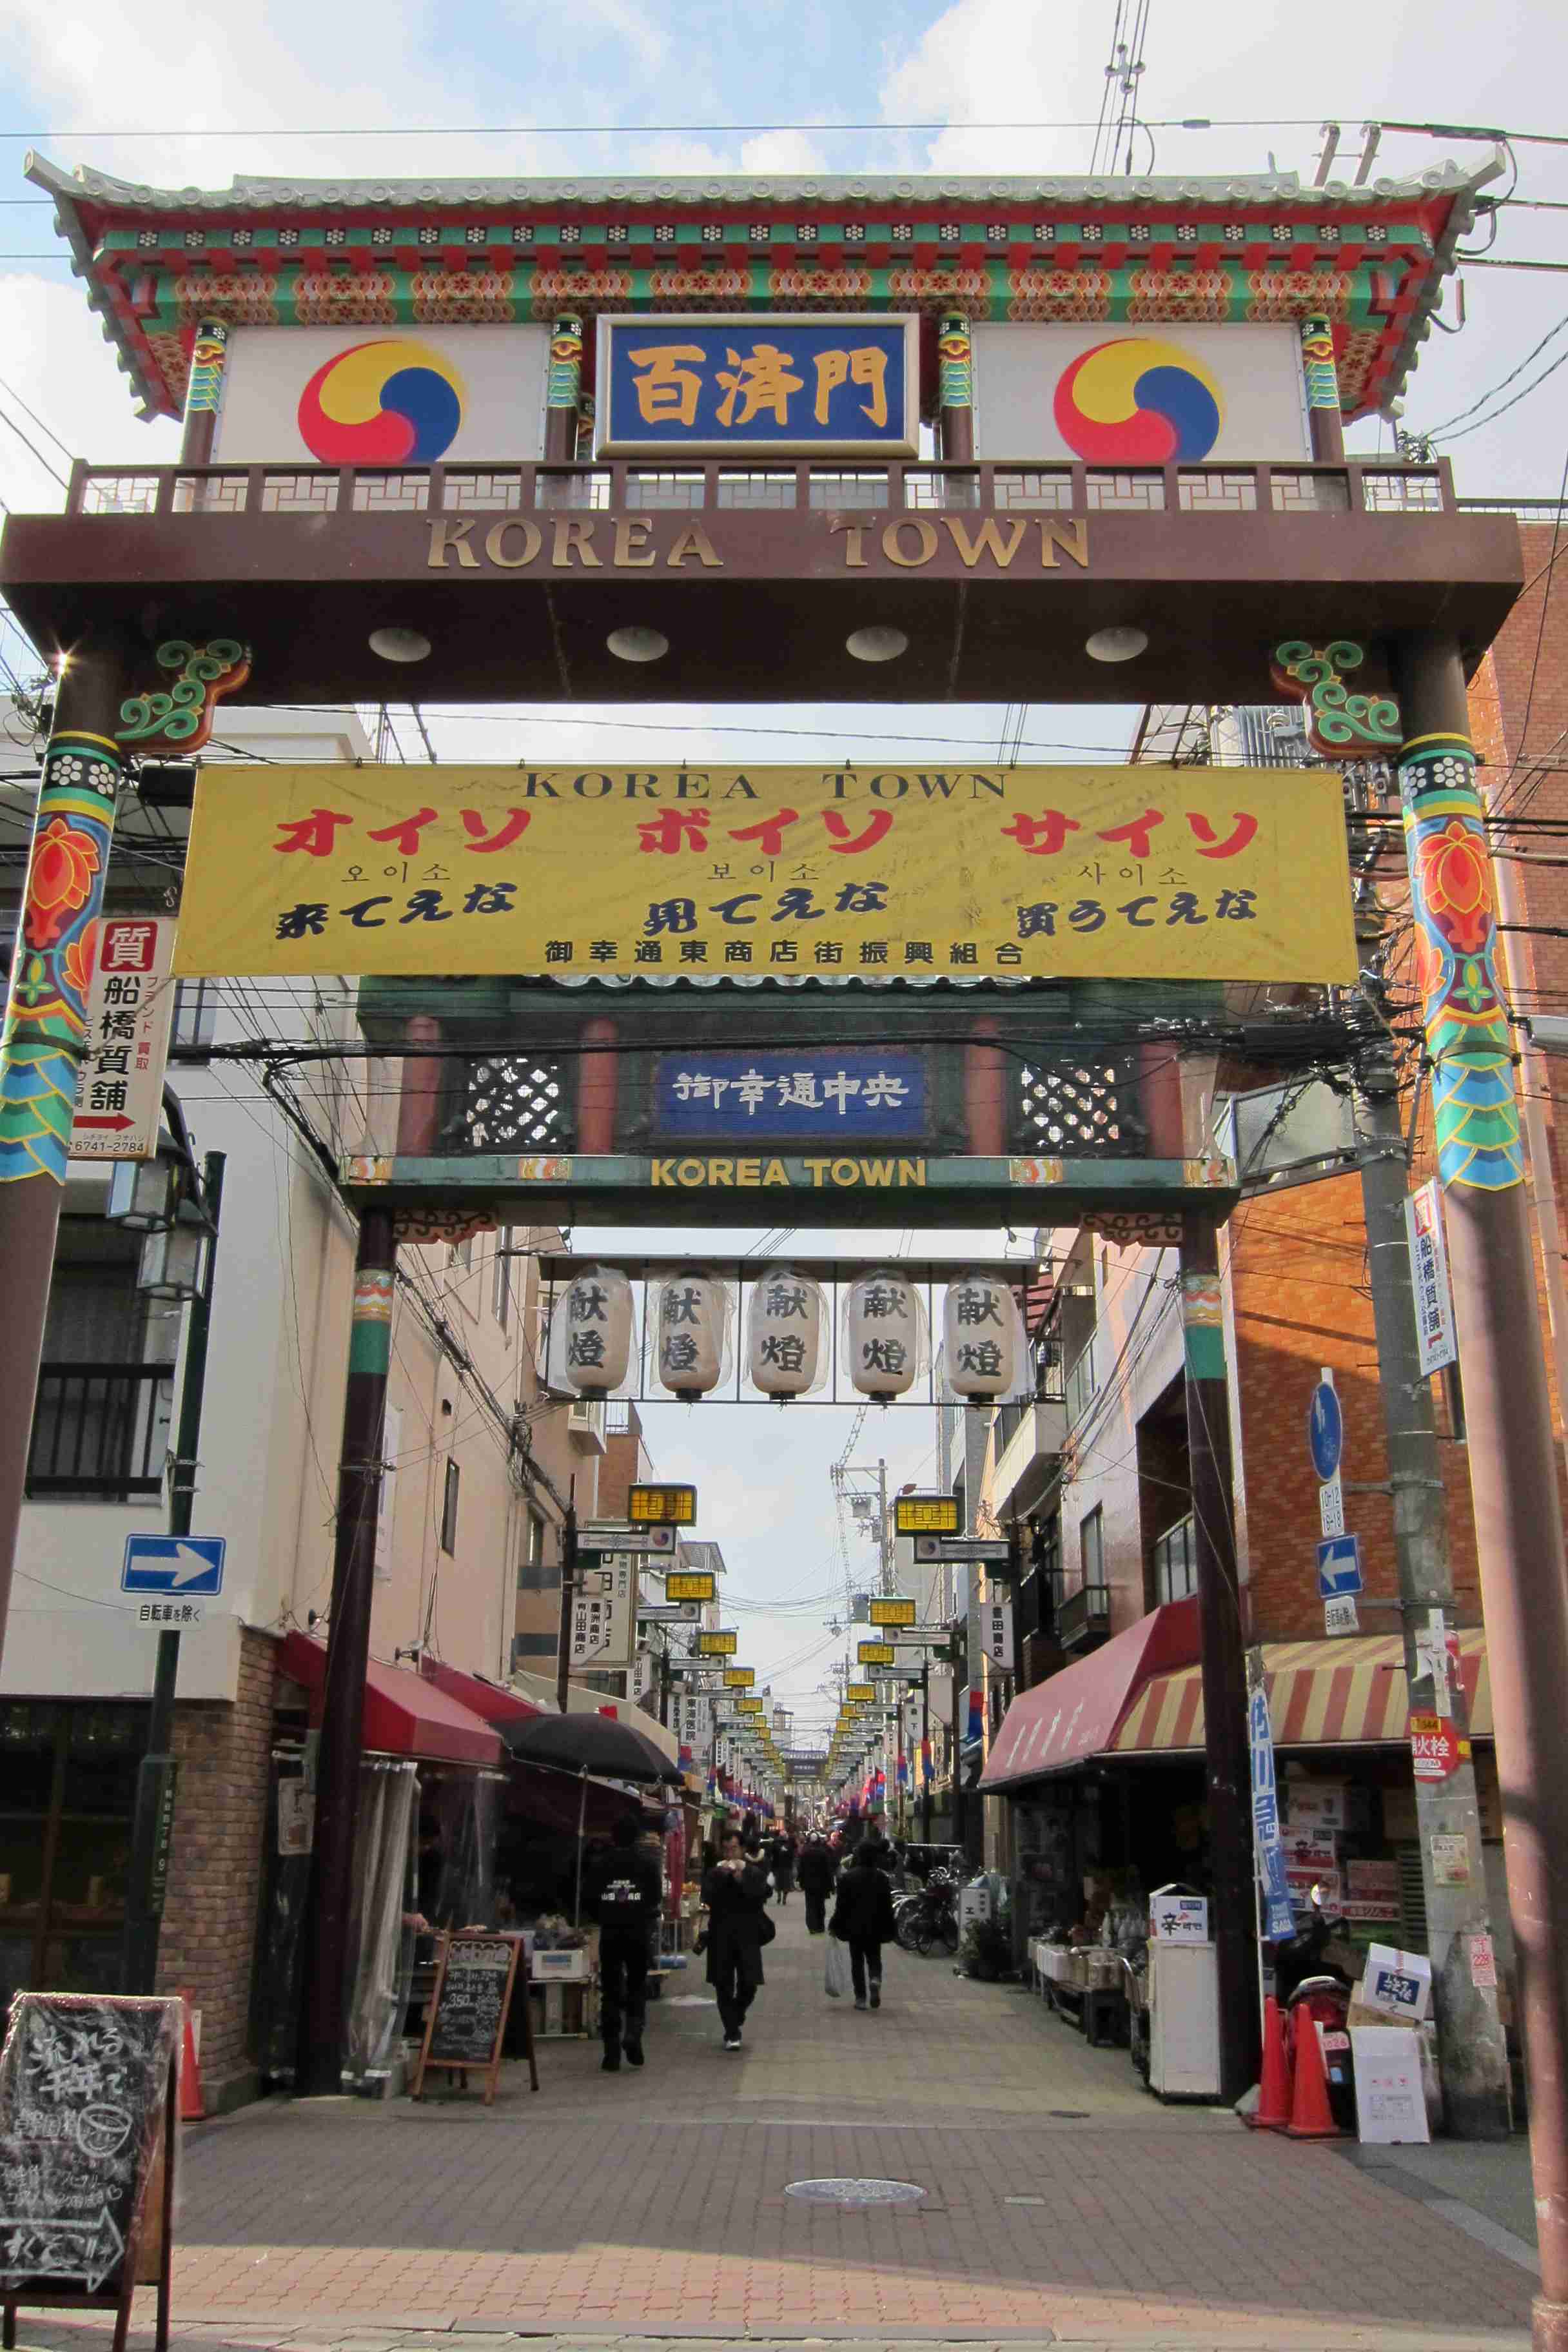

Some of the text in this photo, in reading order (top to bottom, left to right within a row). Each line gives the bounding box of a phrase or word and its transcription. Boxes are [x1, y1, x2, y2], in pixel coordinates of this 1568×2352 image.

[426, 516, 1089, 568] KOREA TOWN
[522, 772, 1006, 799] KOREA TOWN
[273, 807, 1258, 859] オイソ ボイソ サイソ
[275, 881, 1258, 940] 来てえな 見てえな 買うてえな
[108, 927, 151, 968] 質
[545, 939, 1024, 965] 御幸通東商店街振興組合
[90, 976, 141, 1111] 船橋質舗
[672, 1068, 910, 1115] 御幸通中央
[651, 1159, 926, 1187] KOREA TOWN
[139, 1603, 201, 1622] 自転車を除く
